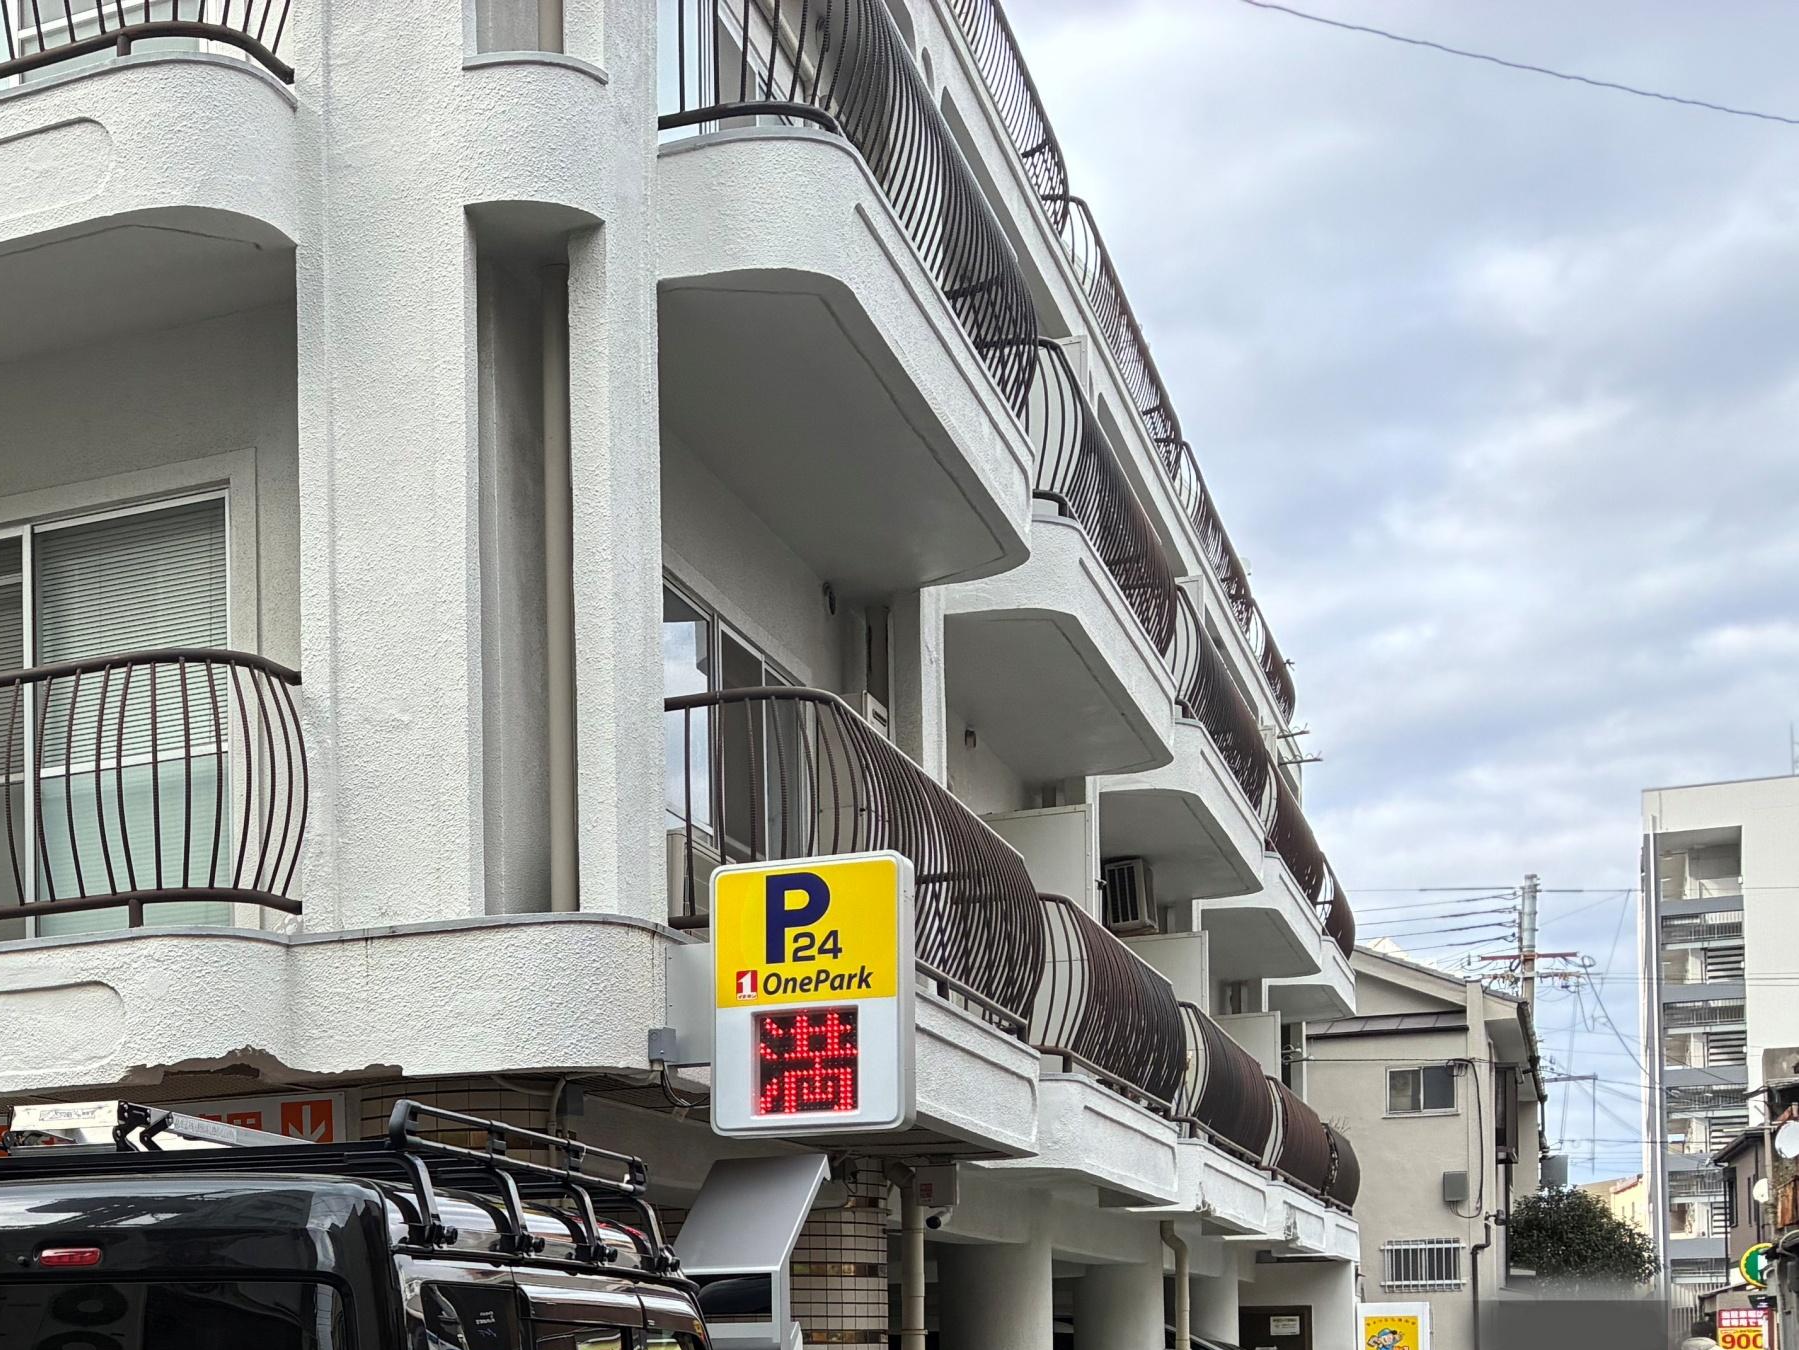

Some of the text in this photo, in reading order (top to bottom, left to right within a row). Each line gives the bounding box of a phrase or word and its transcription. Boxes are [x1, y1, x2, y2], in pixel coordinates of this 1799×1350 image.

[766, 872, 842, 964] P 24
[763, 966, 874, 996] OnePark
[759, 1009, 858, 1115] 満
